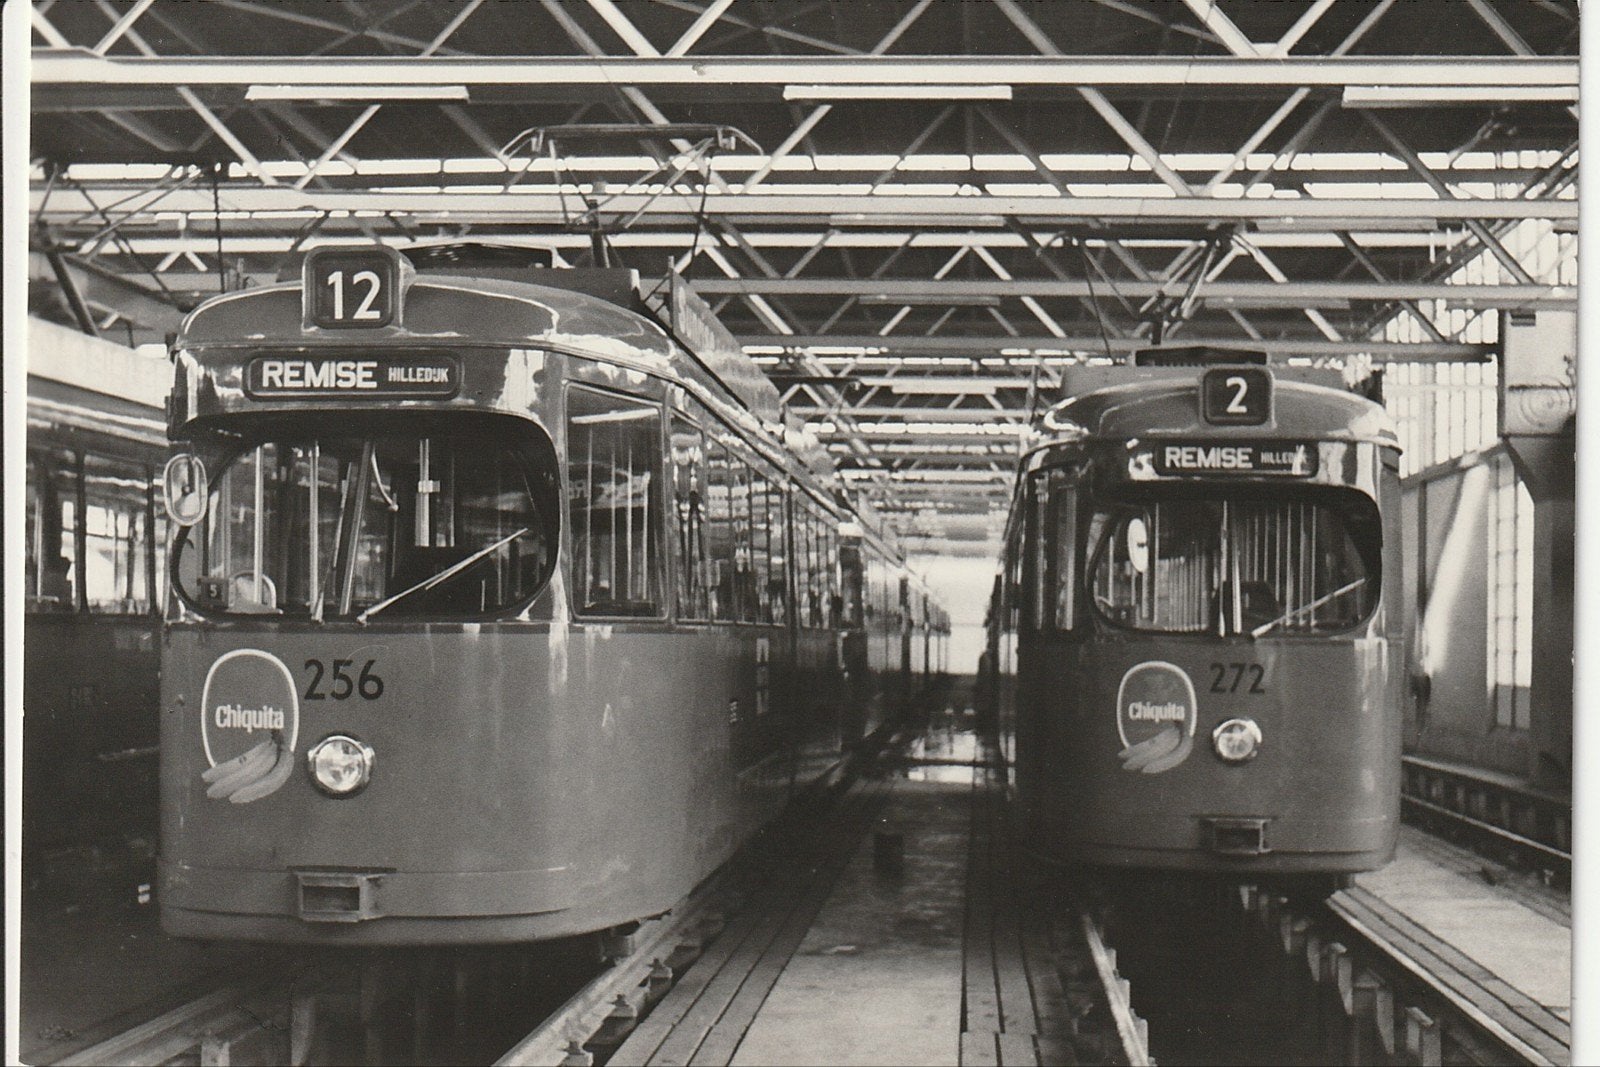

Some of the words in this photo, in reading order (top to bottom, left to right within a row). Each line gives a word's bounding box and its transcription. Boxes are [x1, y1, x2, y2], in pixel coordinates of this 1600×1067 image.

[327, 270, 381, 320] 12
[262, 361, 378, 389] REMISE
[388, 367, 449, 383] HILLEDIJK
[1225, 376, 1248, 413] 2
[1165, 446, 1253, 469] REMISE
[303, 658, 385, 701] 256
[1209, 661, 1266, 695] 272
[215, 704, 285, 734] Chiquita
[1128, 701, 1186, 724] Chiquita
